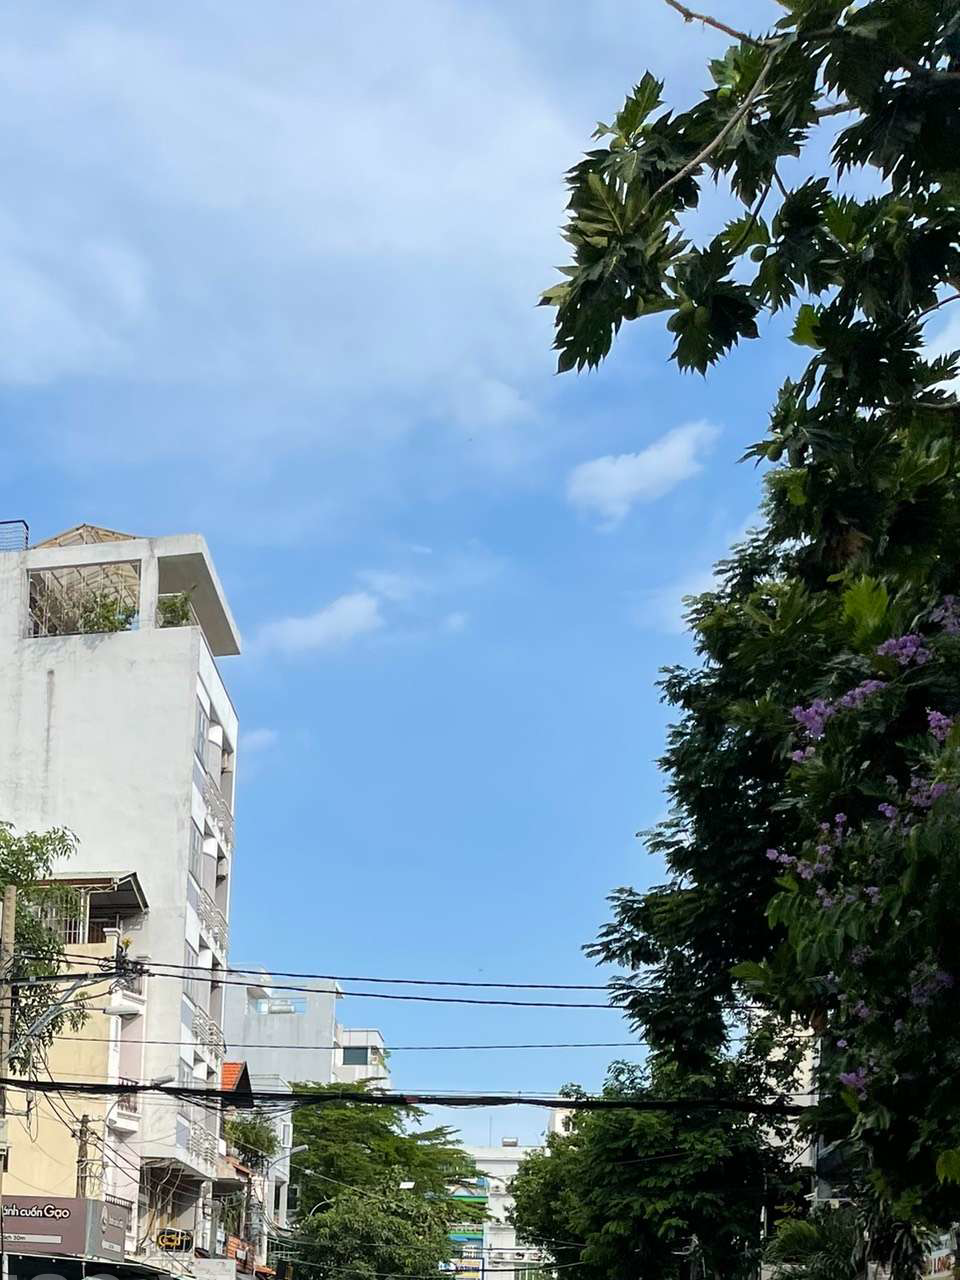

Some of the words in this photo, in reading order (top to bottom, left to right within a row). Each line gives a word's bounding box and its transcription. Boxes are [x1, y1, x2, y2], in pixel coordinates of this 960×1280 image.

[1, 1203, 19, 1217] ánh
[19, 1204, 43, 1218] cuốn
[43, 1203, 71, 1220] Gạo
